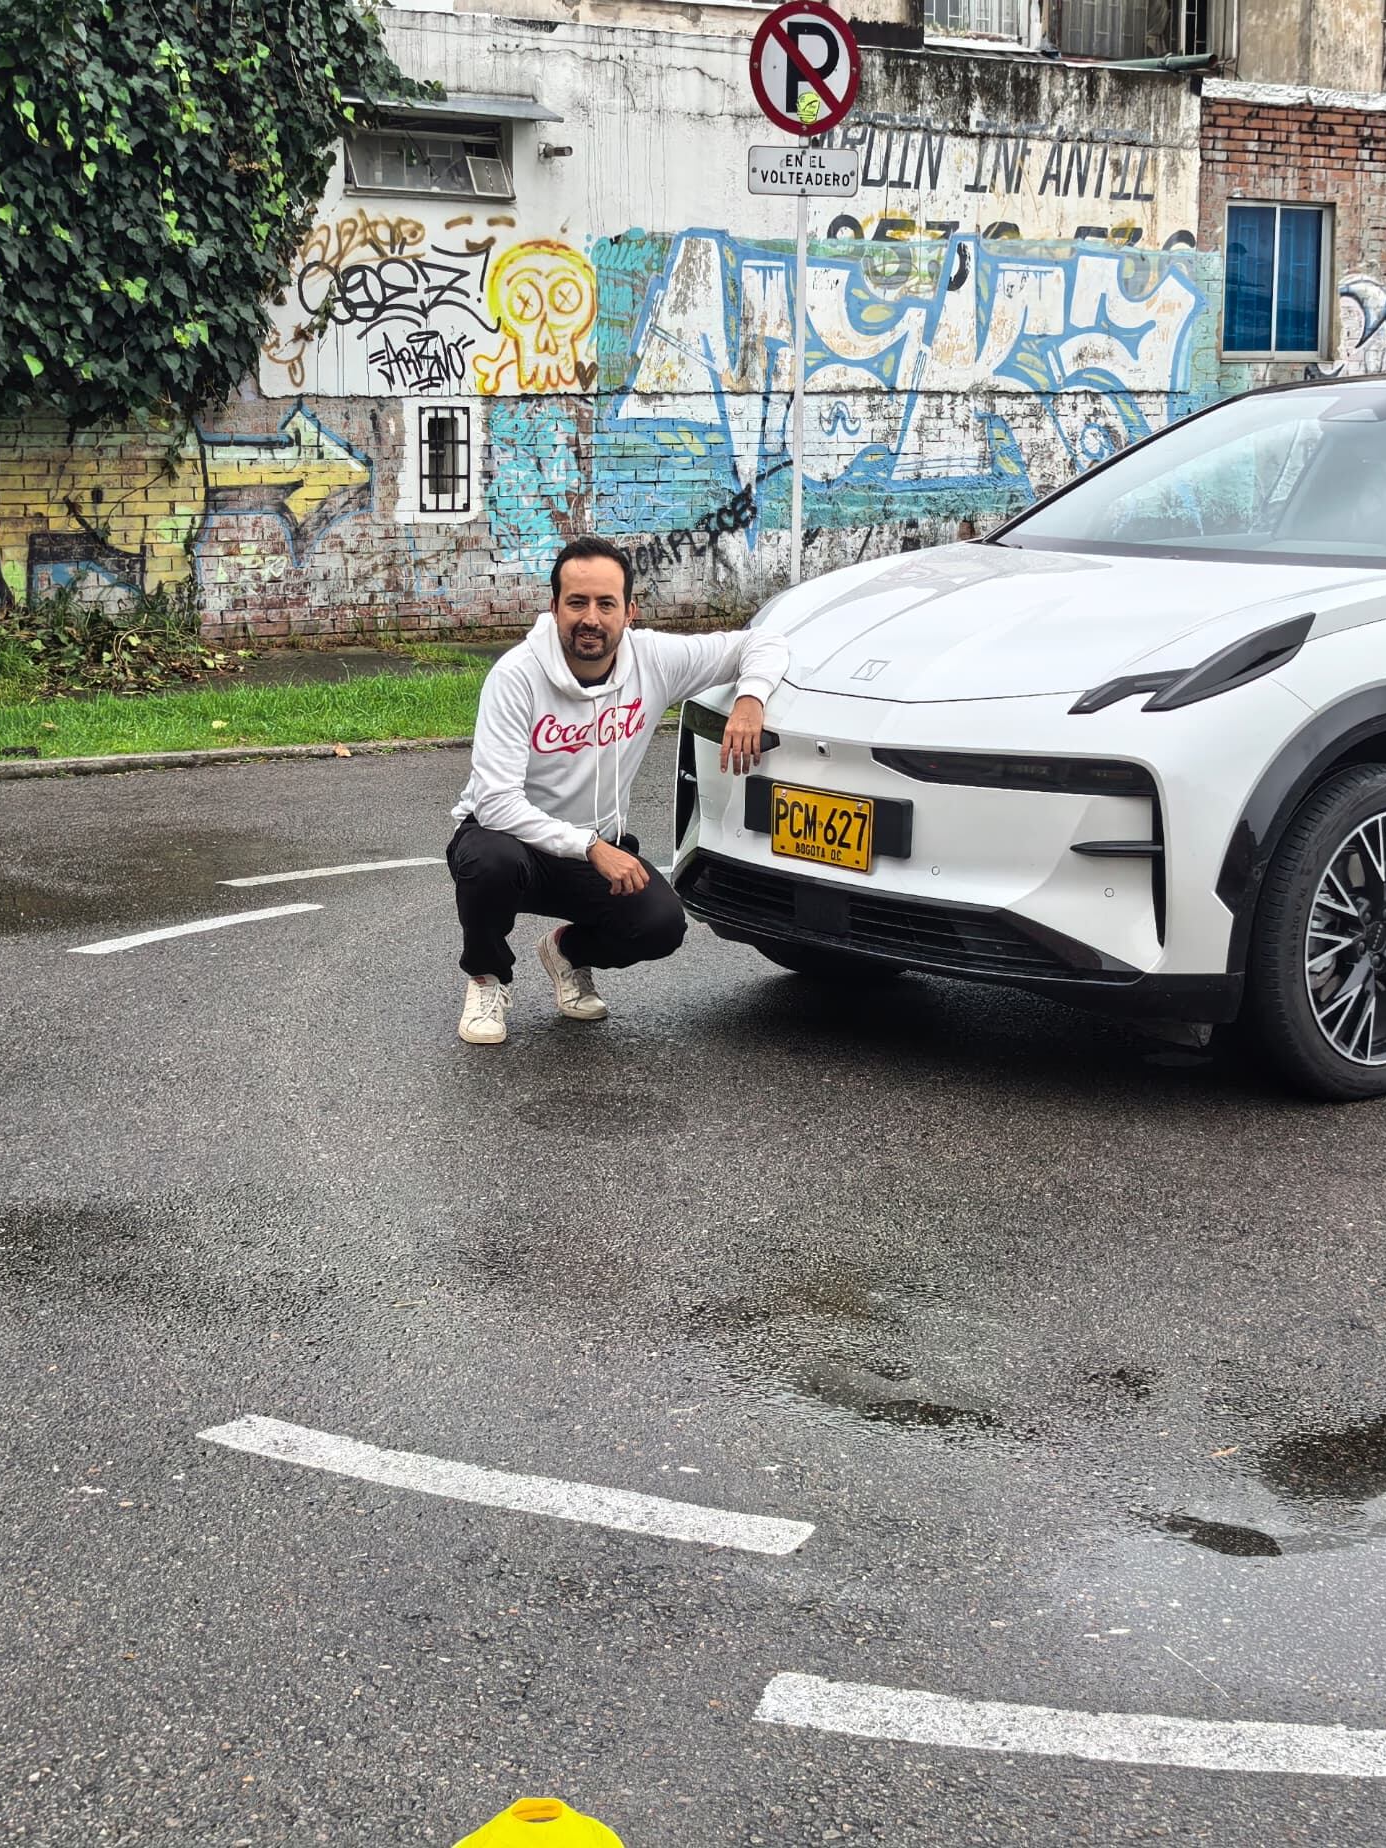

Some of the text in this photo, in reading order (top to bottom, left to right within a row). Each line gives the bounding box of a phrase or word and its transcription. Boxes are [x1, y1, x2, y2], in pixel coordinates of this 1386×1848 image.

[785, 154, 826, 169] EN EL
[760, 169, 850, 187] VOLTEADERO
[531, 697, 646, 754] Coca Cola
[775, 797, 868, 852] PCM 627
[795, 841, 826, 858] BOGOTA
